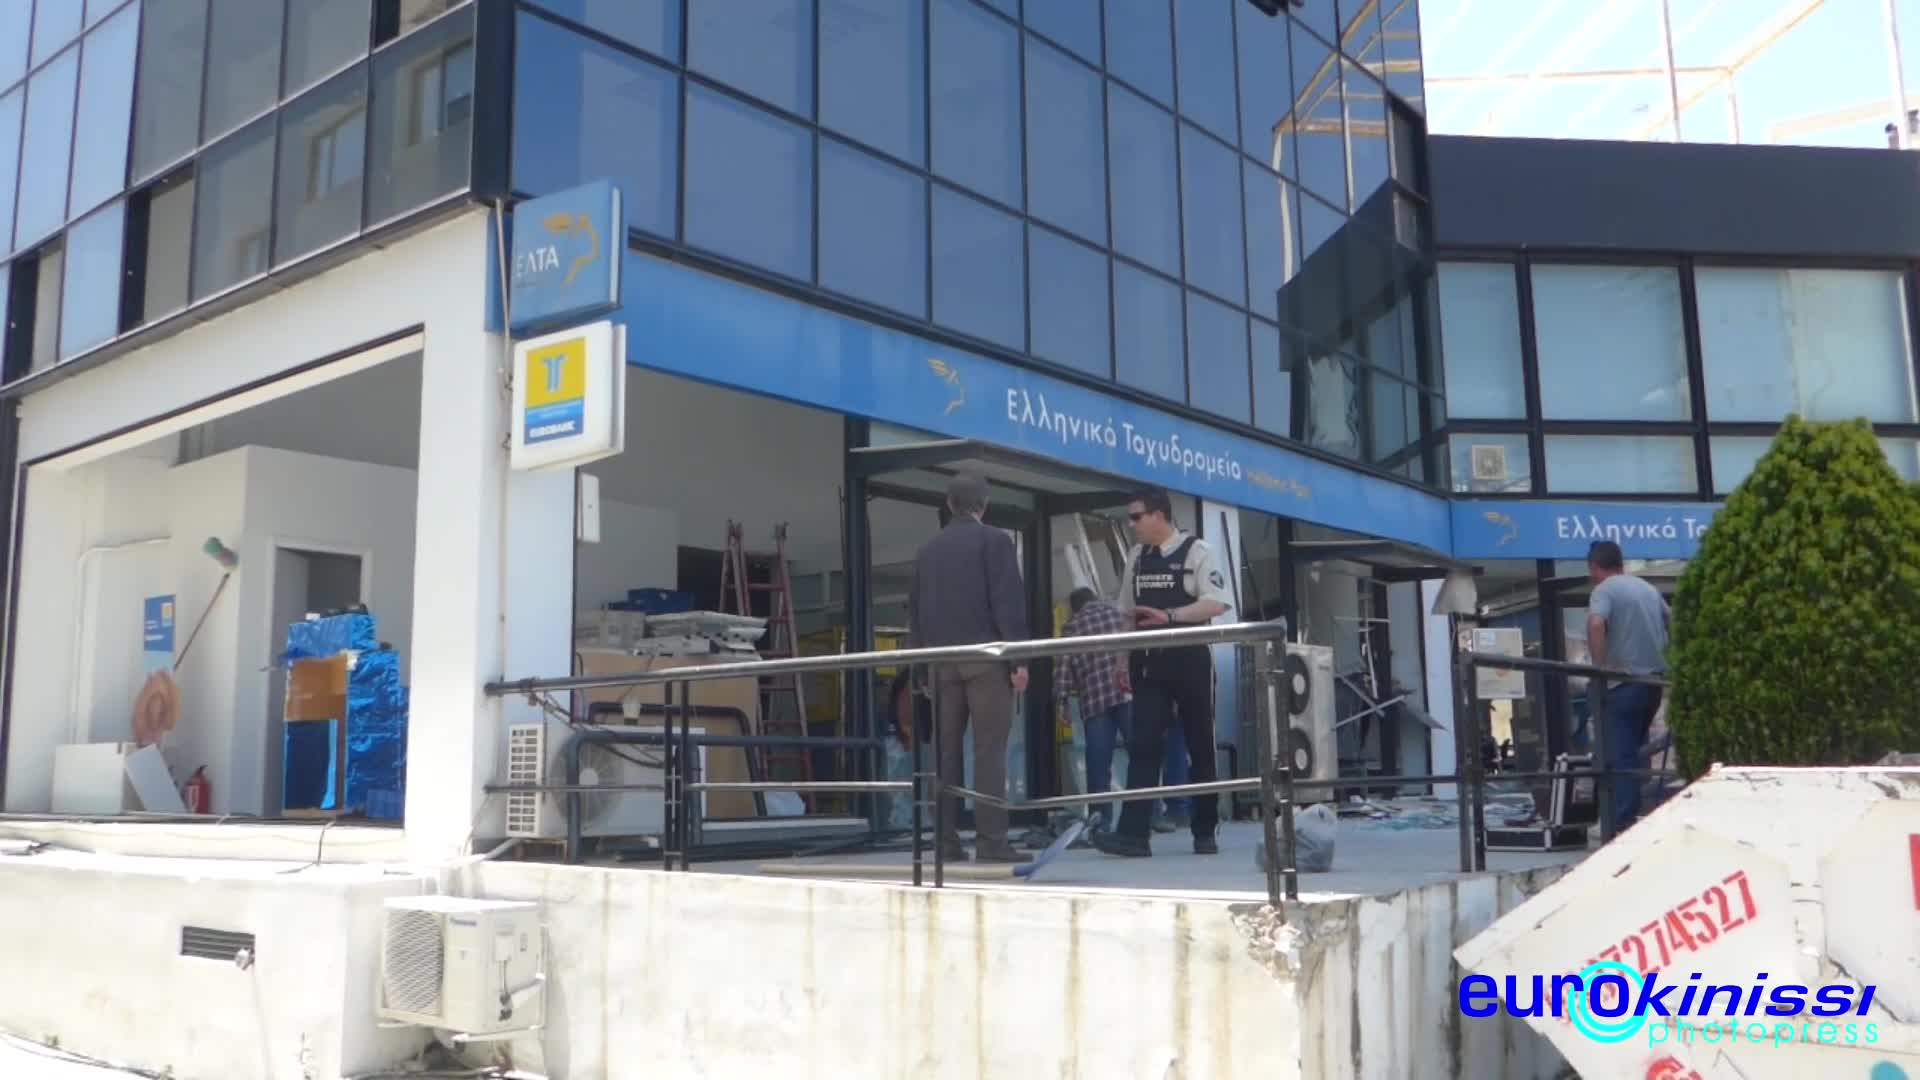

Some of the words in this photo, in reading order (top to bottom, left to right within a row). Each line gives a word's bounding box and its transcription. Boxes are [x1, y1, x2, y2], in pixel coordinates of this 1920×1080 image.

[516, 245, 559, 278] ΕΛΤΑ
[1006, 388, 1117, 445] Ελληνικά
[1121, 422, 1242, 481] Ταχυδρομεία
[1557, 514, 1677, 545] Ελληνικά
